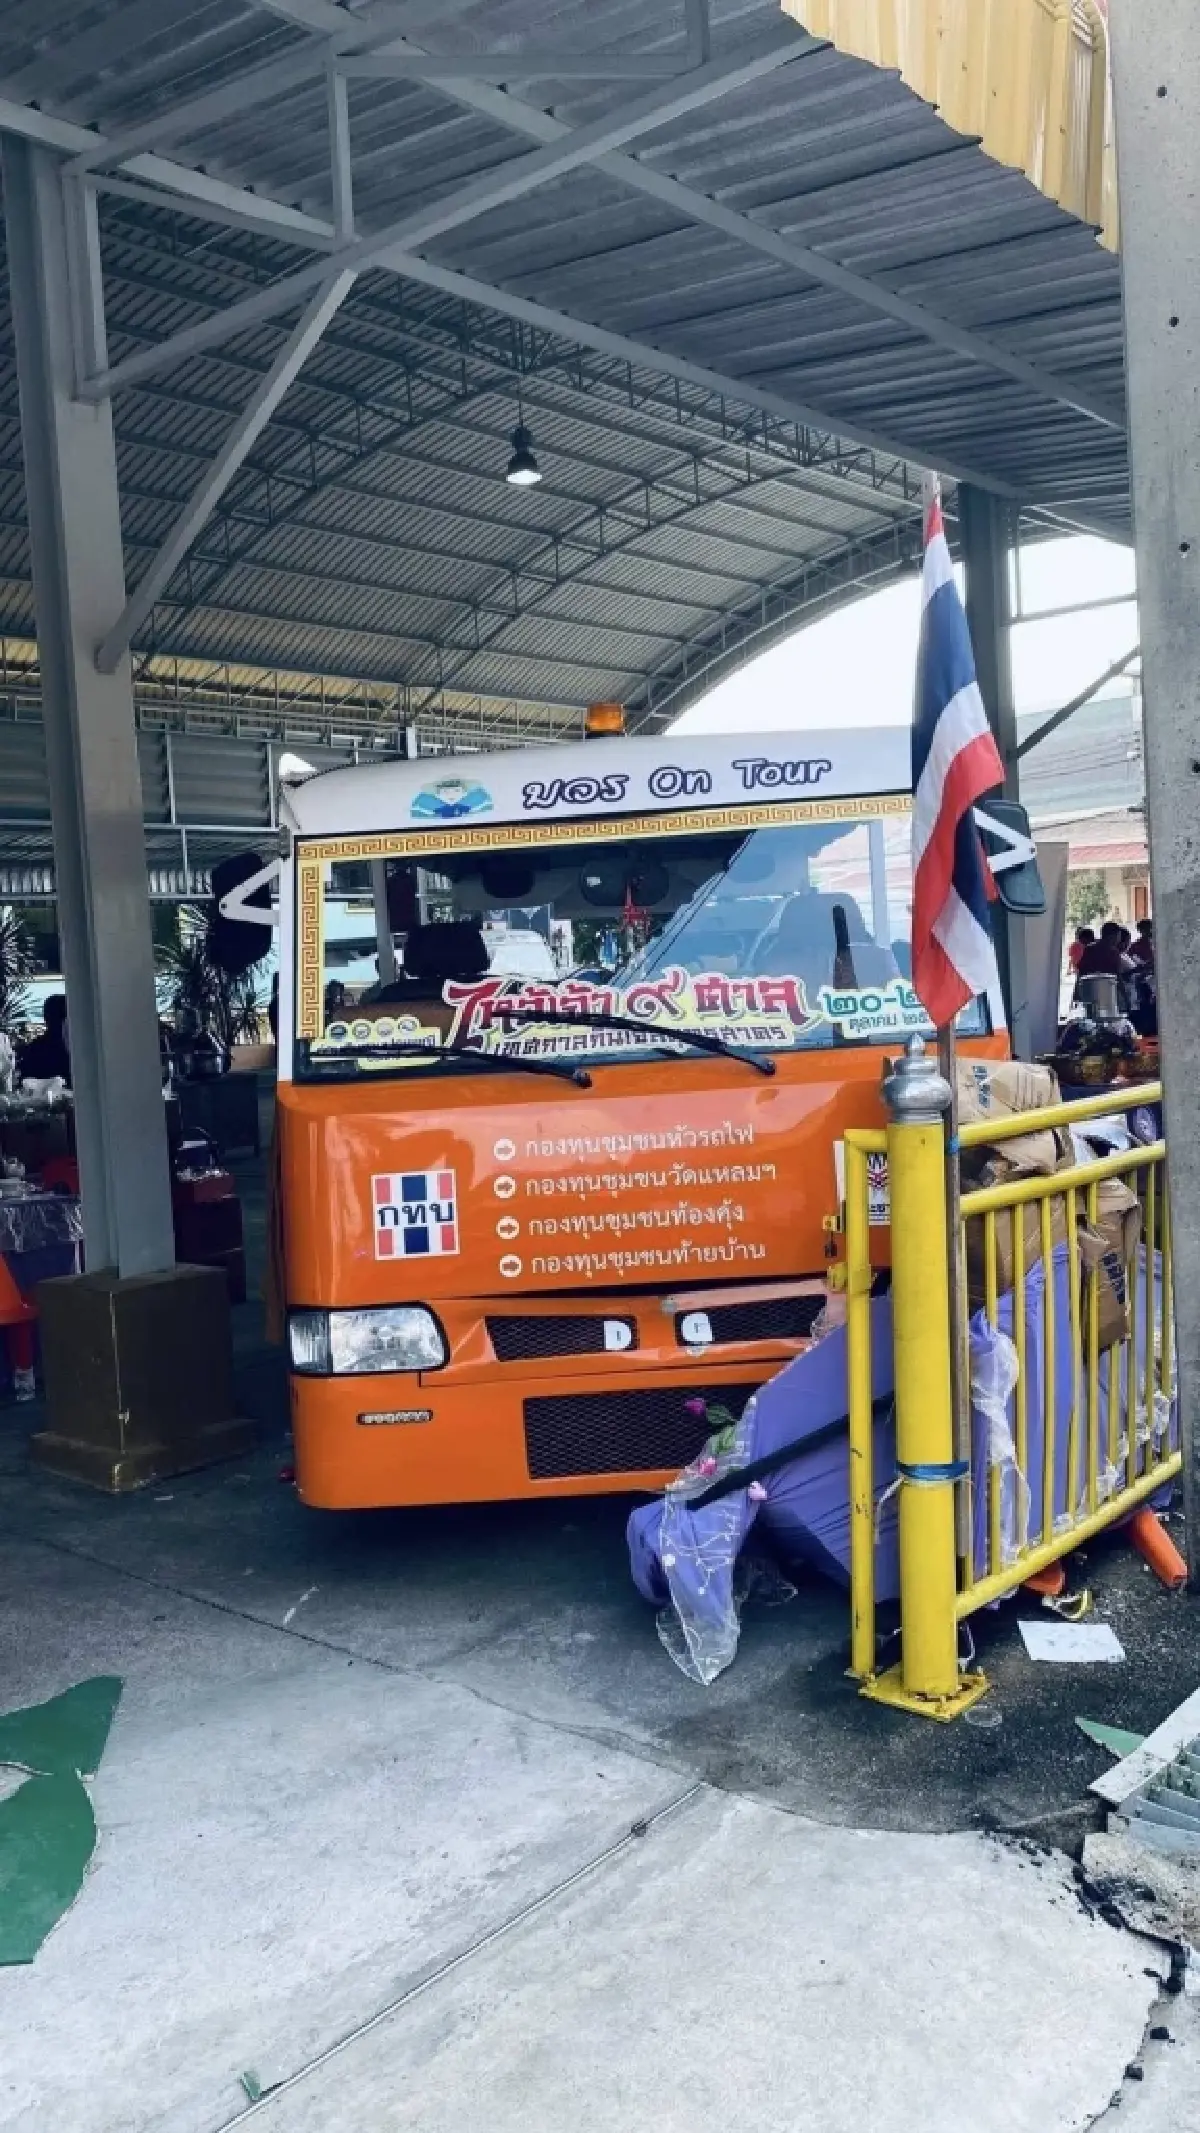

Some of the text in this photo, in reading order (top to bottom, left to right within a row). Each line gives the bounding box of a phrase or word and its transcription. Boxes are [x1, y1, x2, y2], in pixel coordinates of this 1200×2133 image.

[648, 764, 713, 799] On
[731, 757, 832, 790] Tour
[822, 984, 922, 1017] ๒๐-๒
[525, 1120, 755, 1162] กองทุนชุมชนหัวรถไฟ
[525, 1162, 776, 1201] กองทุนชุมชนวัดแหลมฯ
[377, 1202, 454, 1228] กทบ
[528, 1199, 745, 1239] กองทุนชุมชนท้องคุ้ง
[531, 1236, 766, 1279] กองทุนชุมชนท้ายบ้าน
